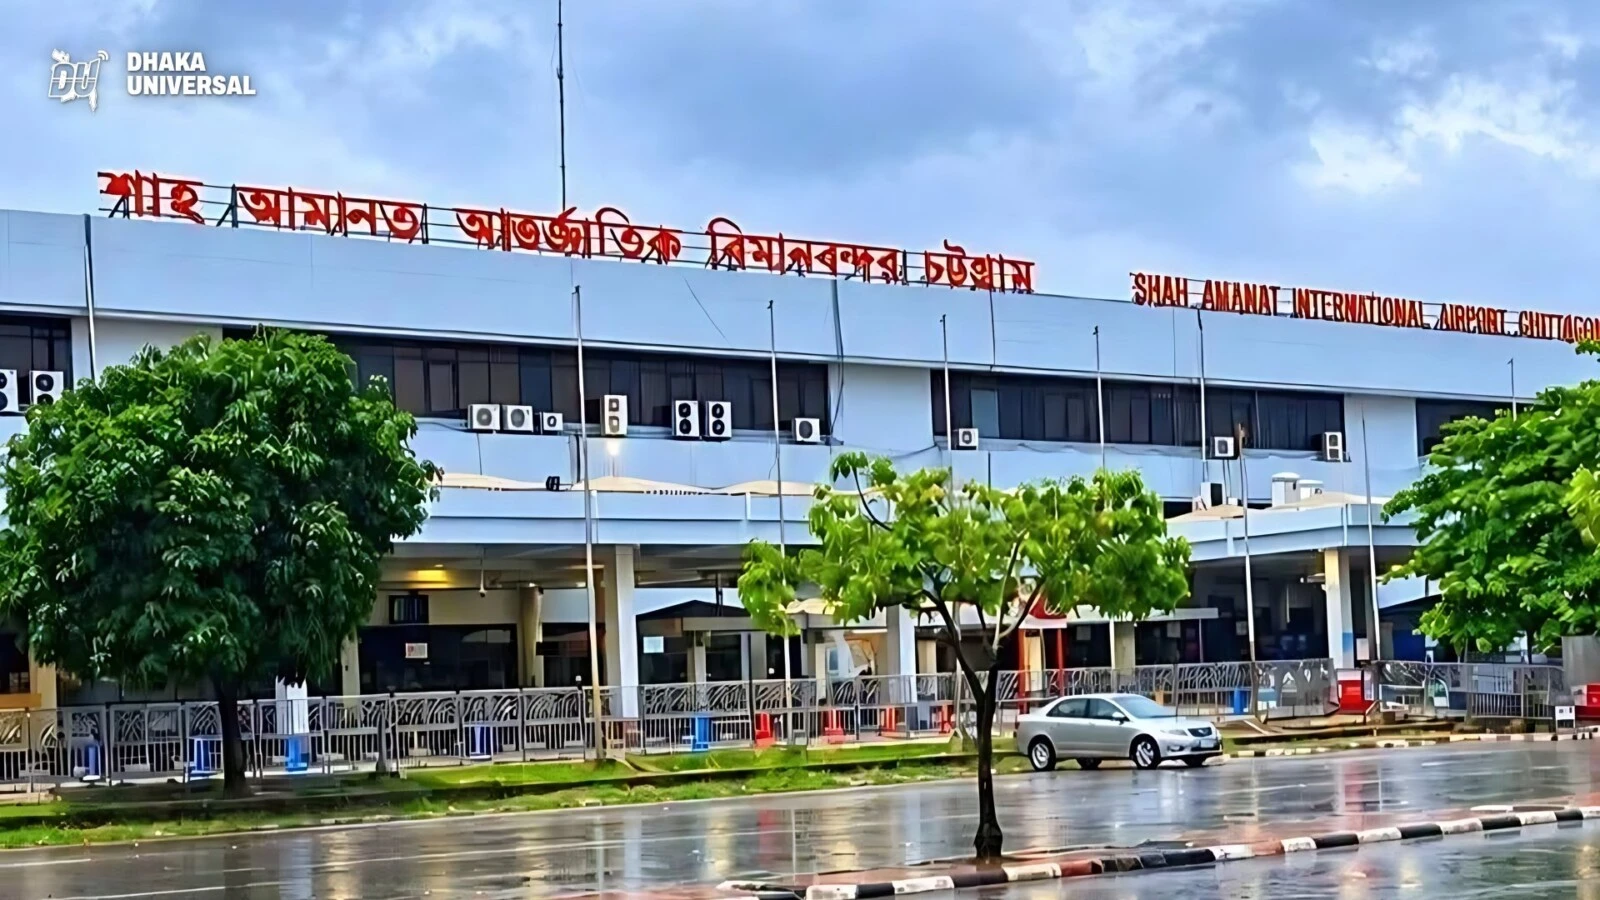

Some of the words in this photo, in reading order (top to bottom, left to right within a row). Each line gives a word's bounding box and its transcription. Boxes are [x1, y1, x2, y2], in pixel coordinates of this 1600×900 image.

[98, 170, 205, 224] শাহ
[235, 184, 424, 240] আমানত
[1134, 273, 1188, 307] SHAH
[1203, 280, 1281, 316] AMANAT
[1292, 288, 1424, 328] INTERNATIONAL
[1439, 303, 1507, 335] AIRPORT
